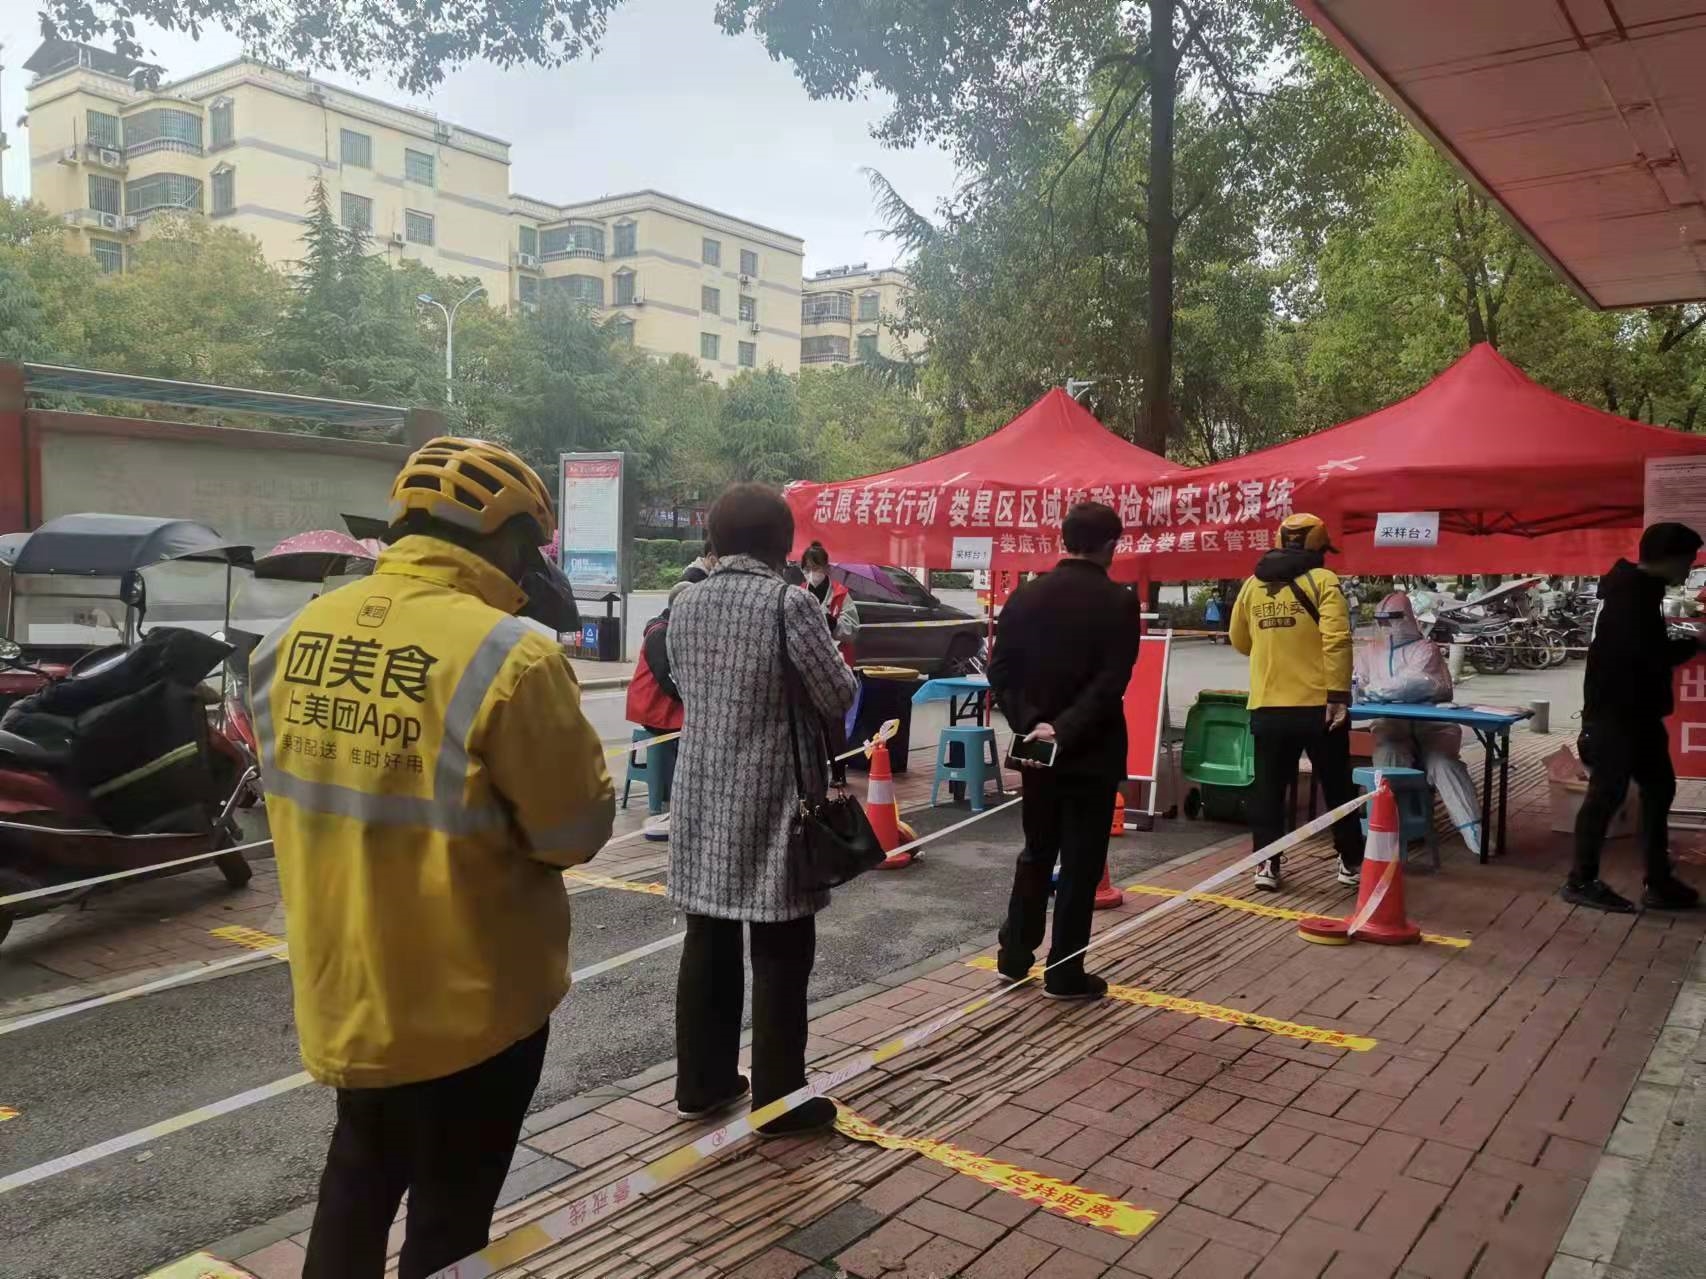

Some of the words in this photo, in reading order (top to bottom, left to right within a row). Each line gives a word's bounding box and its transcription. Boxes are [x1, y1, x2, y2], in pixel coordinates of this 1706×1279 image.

[361, 605, 385, 619] 美团
[284, 630, 439, 704] 团美食
[284, 689, 422, 749] 上美团App
[1006, 1174, 1116, 1219] 保持距离
